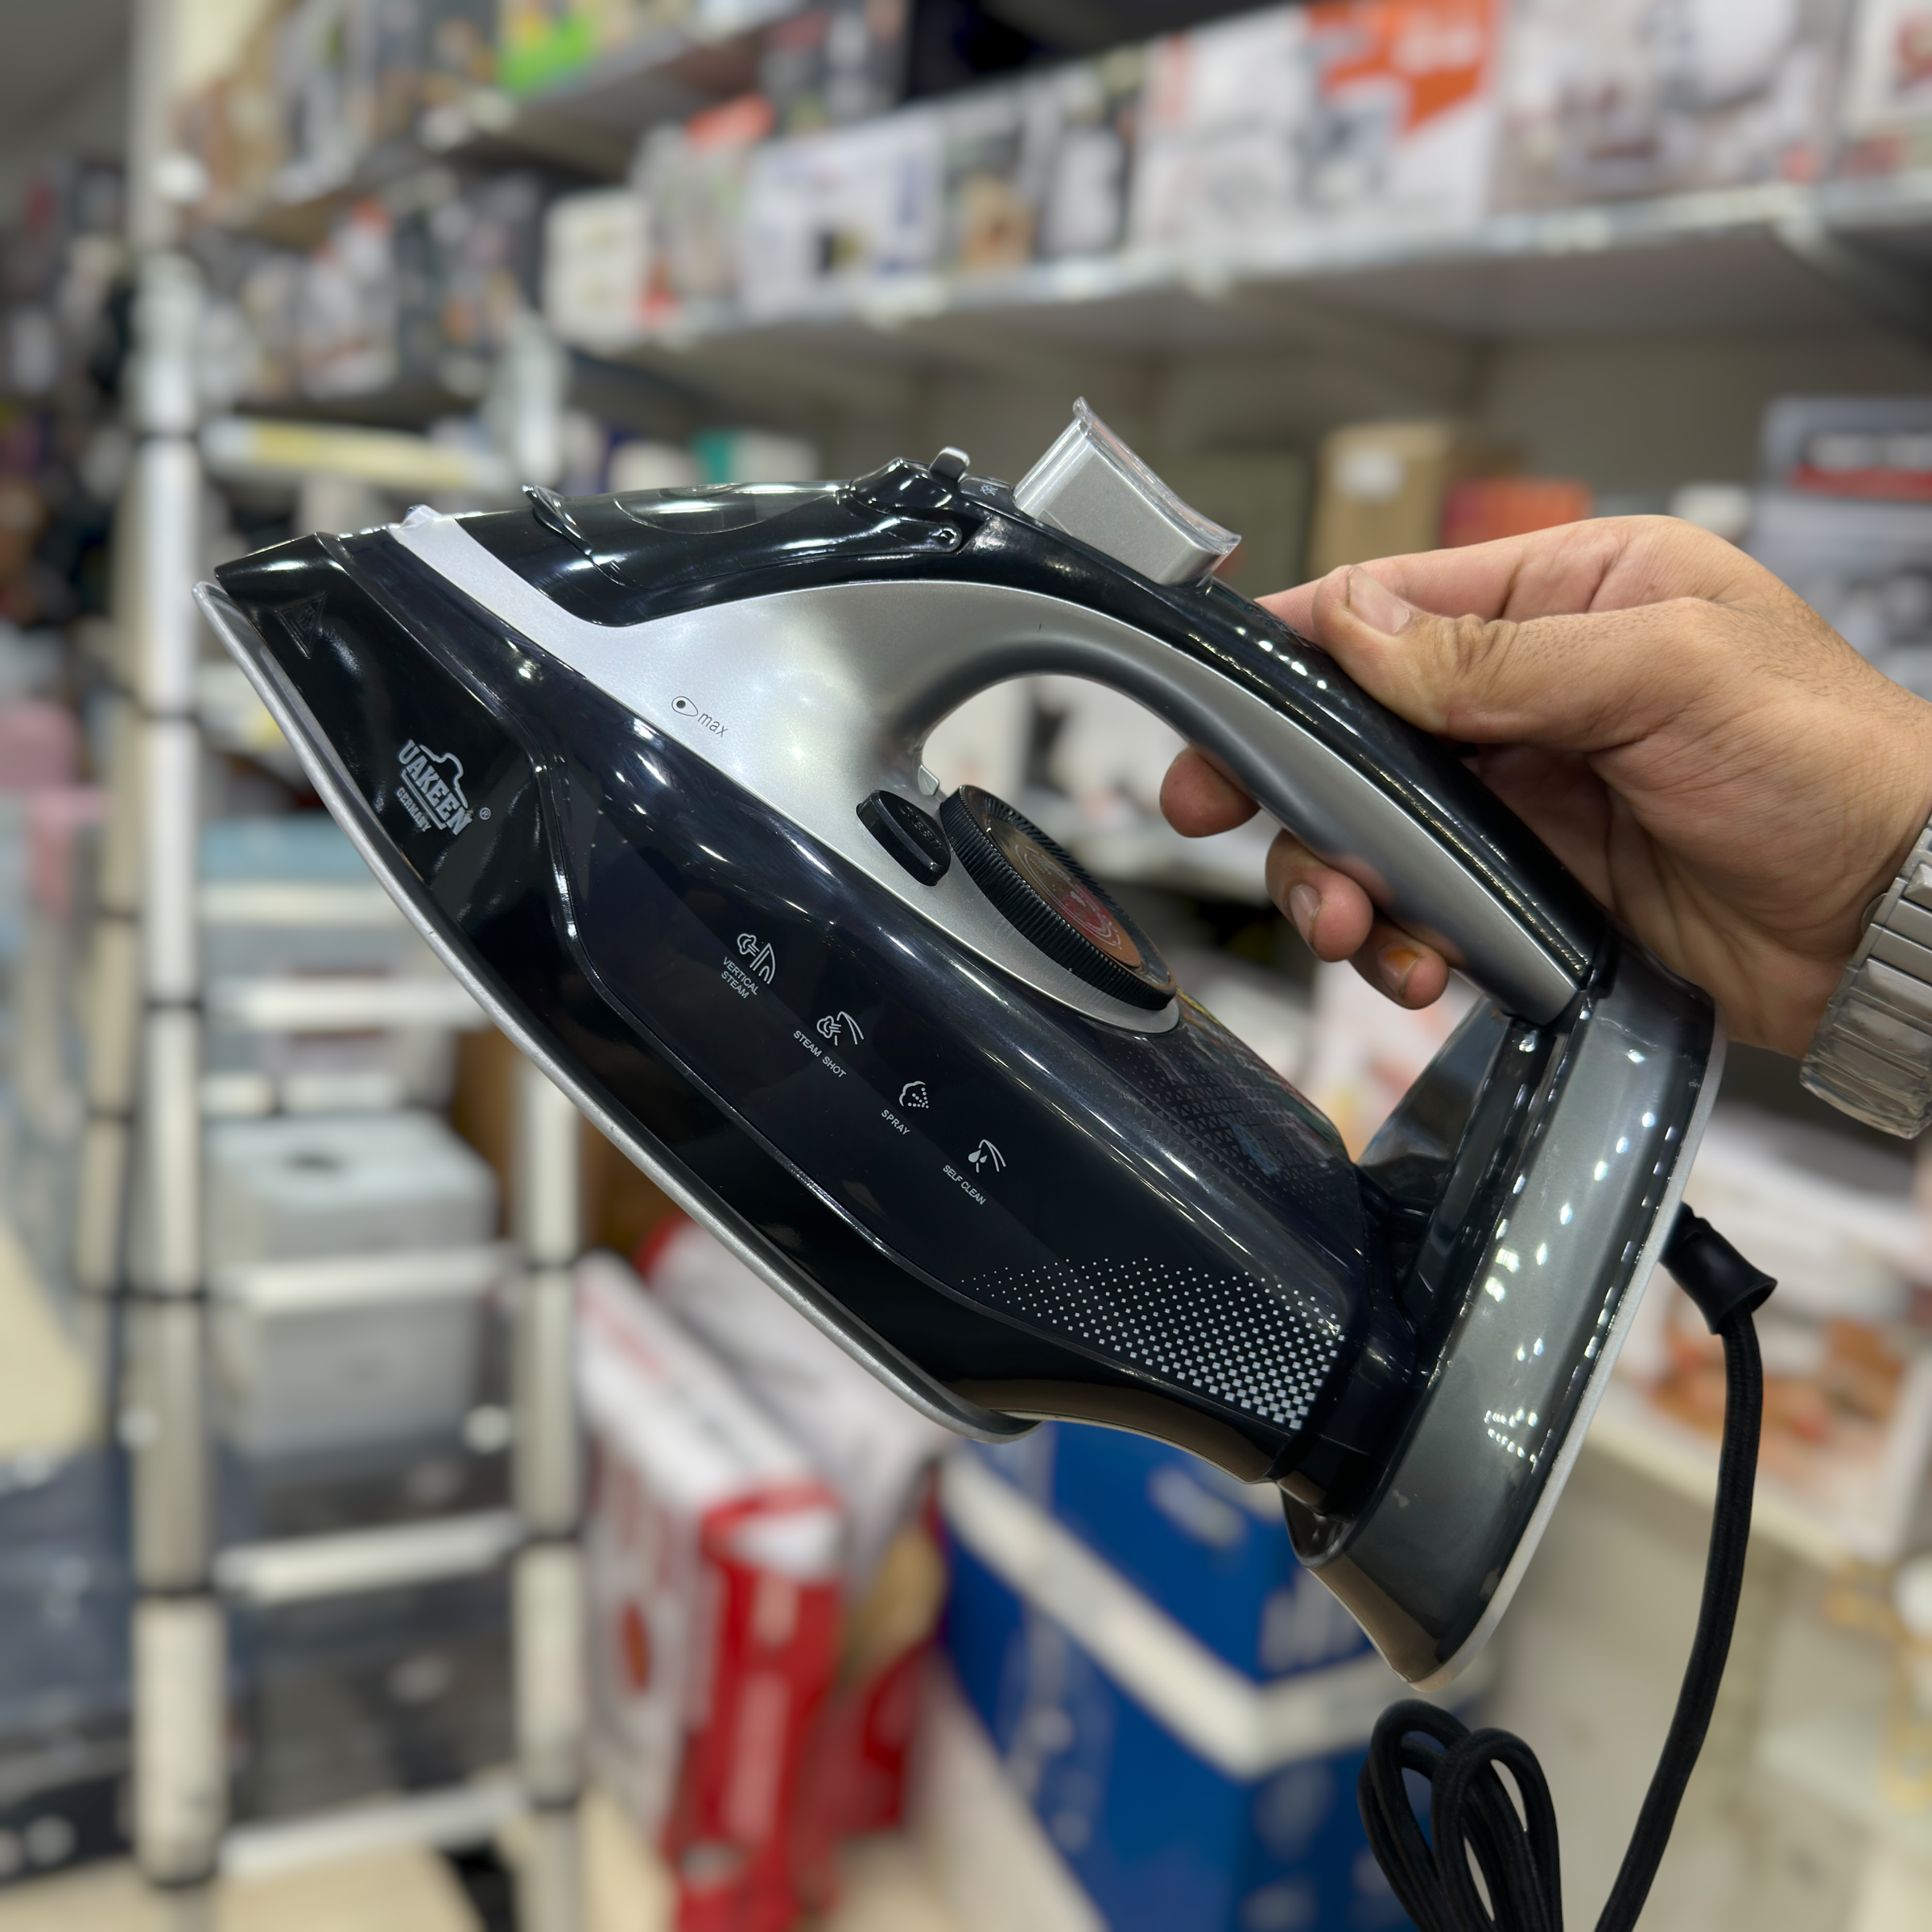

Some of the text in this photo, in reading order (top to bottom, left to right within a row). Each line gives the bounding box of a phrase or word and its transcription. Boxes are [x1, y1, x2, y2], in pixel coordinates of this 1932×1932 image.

[697, 713, 729, 737] max
[399, 739, 473, 836] UAKEEN
[396, 786, 432, 832] GERMANY
[721, 971, 749, 999] STEAM
[723, 956, 759, 996] VERTICAL
[793, 1030, 847, 1078] STEAM SHOT
[881, 1109, 910, 1135] SPRAY
[943, 1164, 987, 1205] SELF CLEAN
